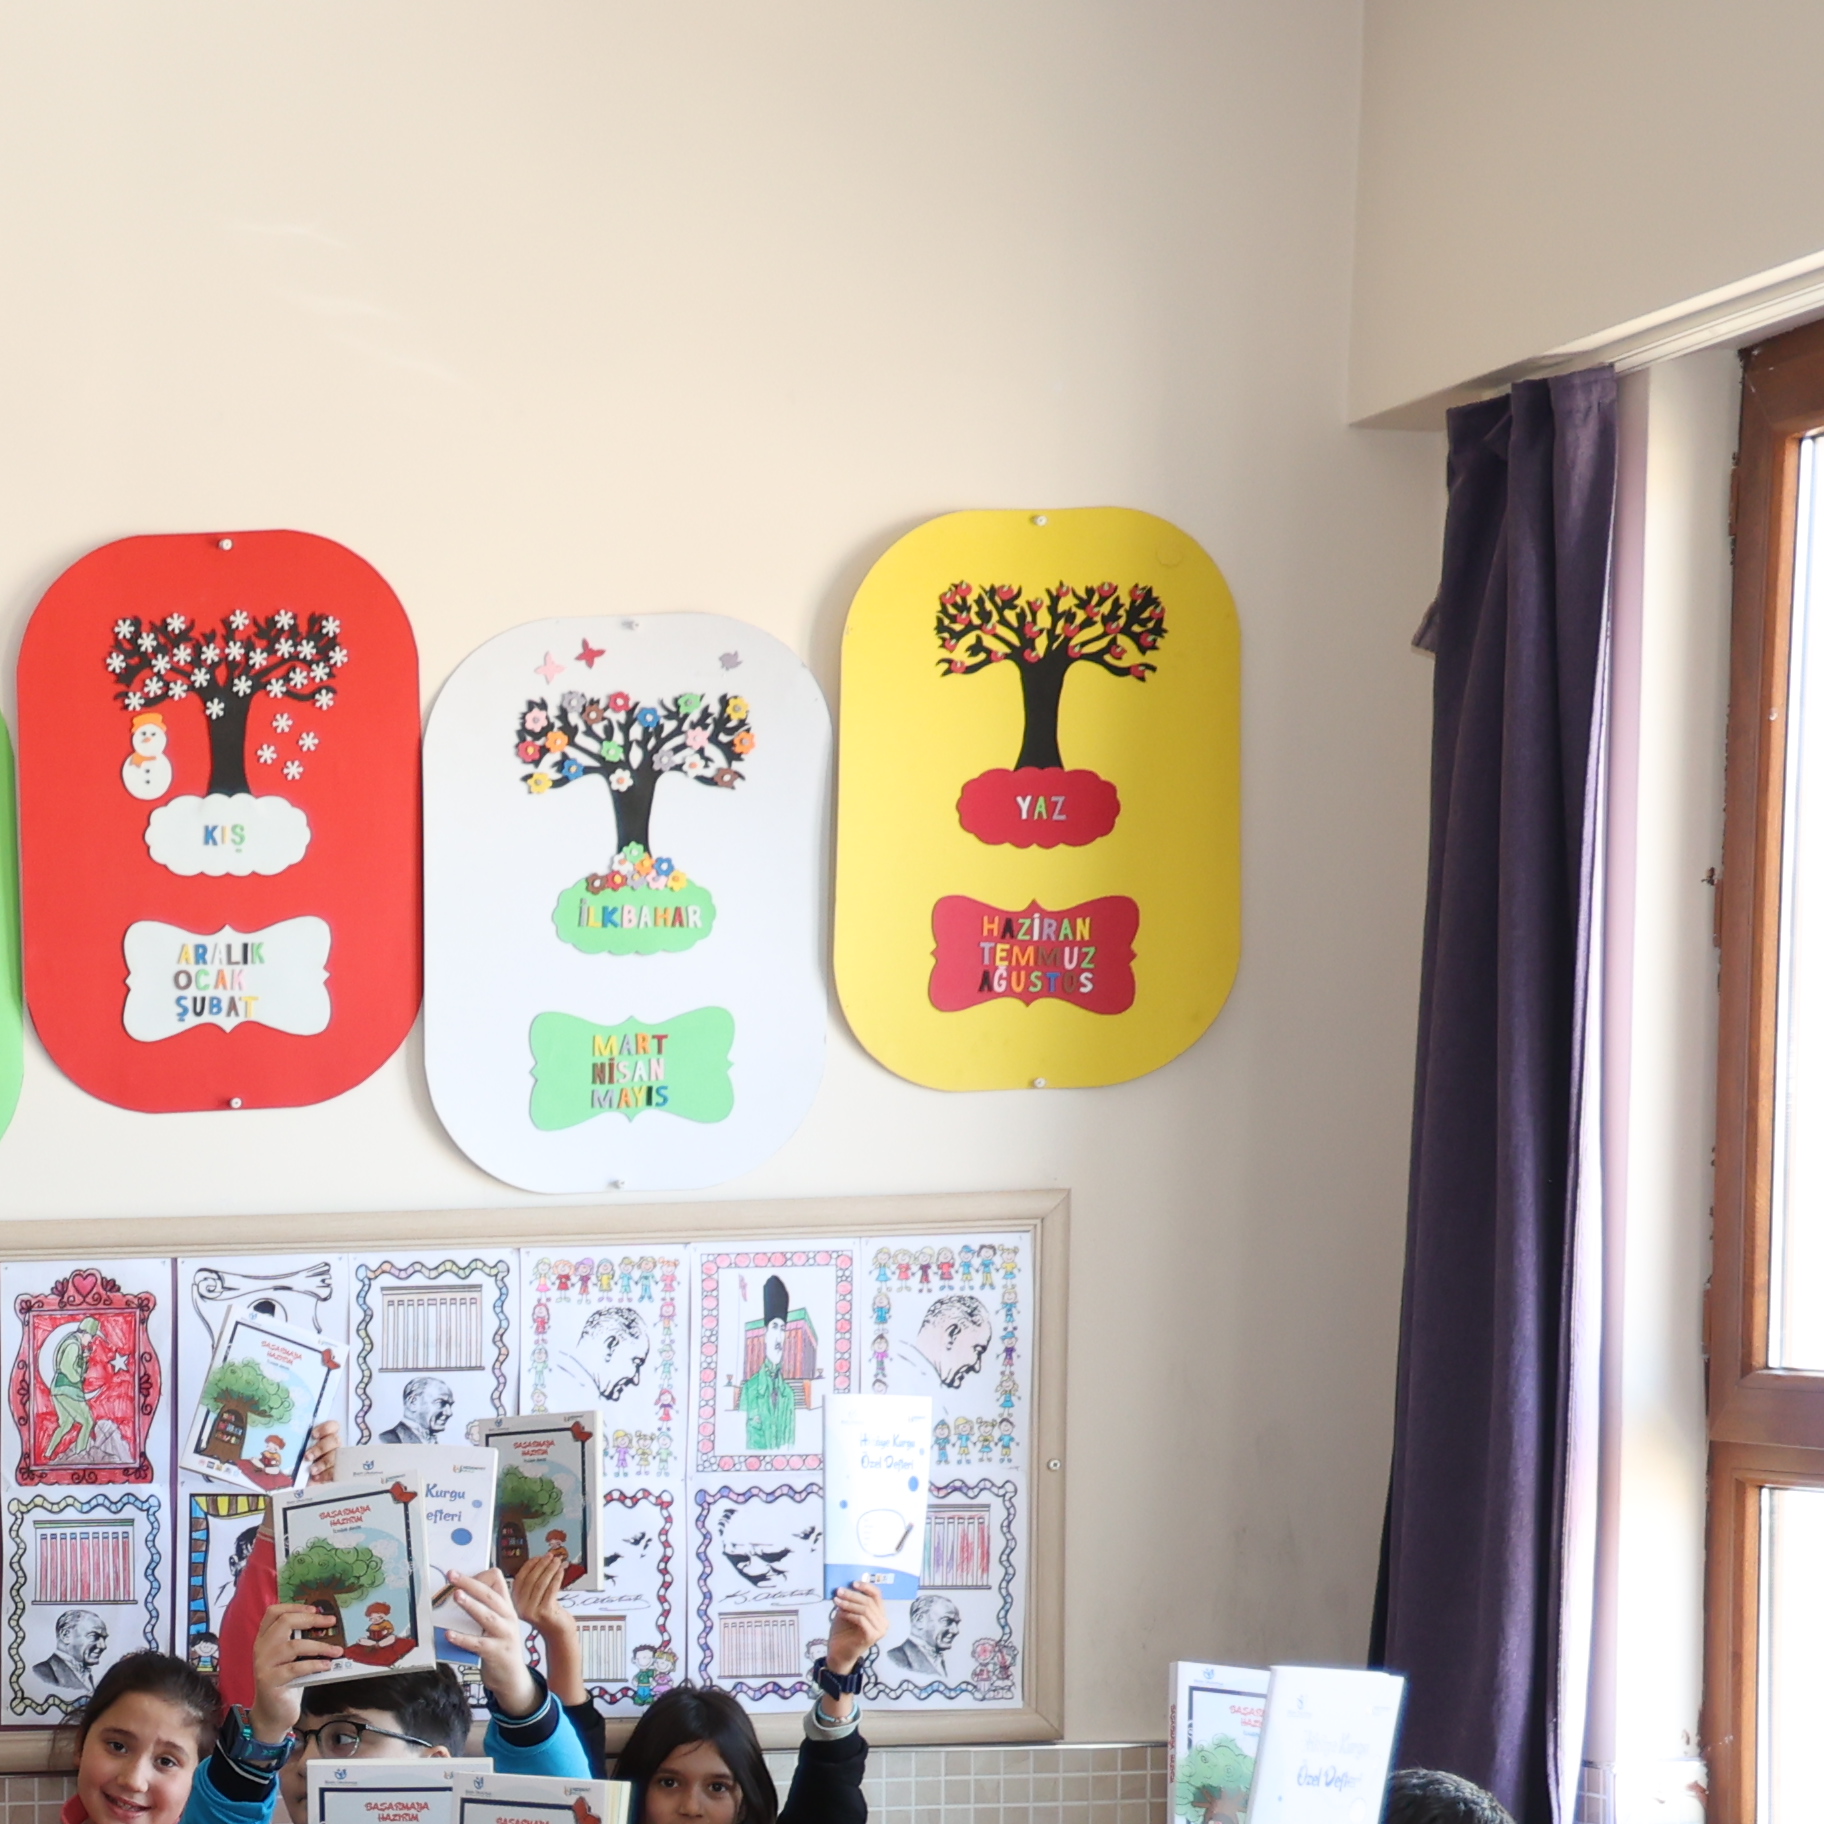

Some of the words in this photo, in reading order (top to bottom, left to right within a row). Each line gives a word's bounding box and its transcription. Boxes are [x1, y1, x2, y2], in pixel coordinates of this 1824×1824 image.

[1016, 795, 1067, 821] YAZ
[204, 822, 246, 852] KIŞ
[579, 898, 702, 929] İLKBAHAR
[982, 913, 1091, 941] HAZİRAN
[177, 942, 265, 966] ARALIK
[979, 942, 1095, 969] TEMMUZ
[173, 969, 245, 991] OCAK
[978, 965, 1094, 995] AĞUSTOS
[175, 995, 258, 1021] ŞUBAT
[593, 1033, 668, 1056] MART
[592, 1055, 666, 1084] NİSAN
[591, 1085, 669, 1108] MAYIS
[425, 1483, 466, 1501] Kurgu
[426, 1511, 462, 1524] efteri
